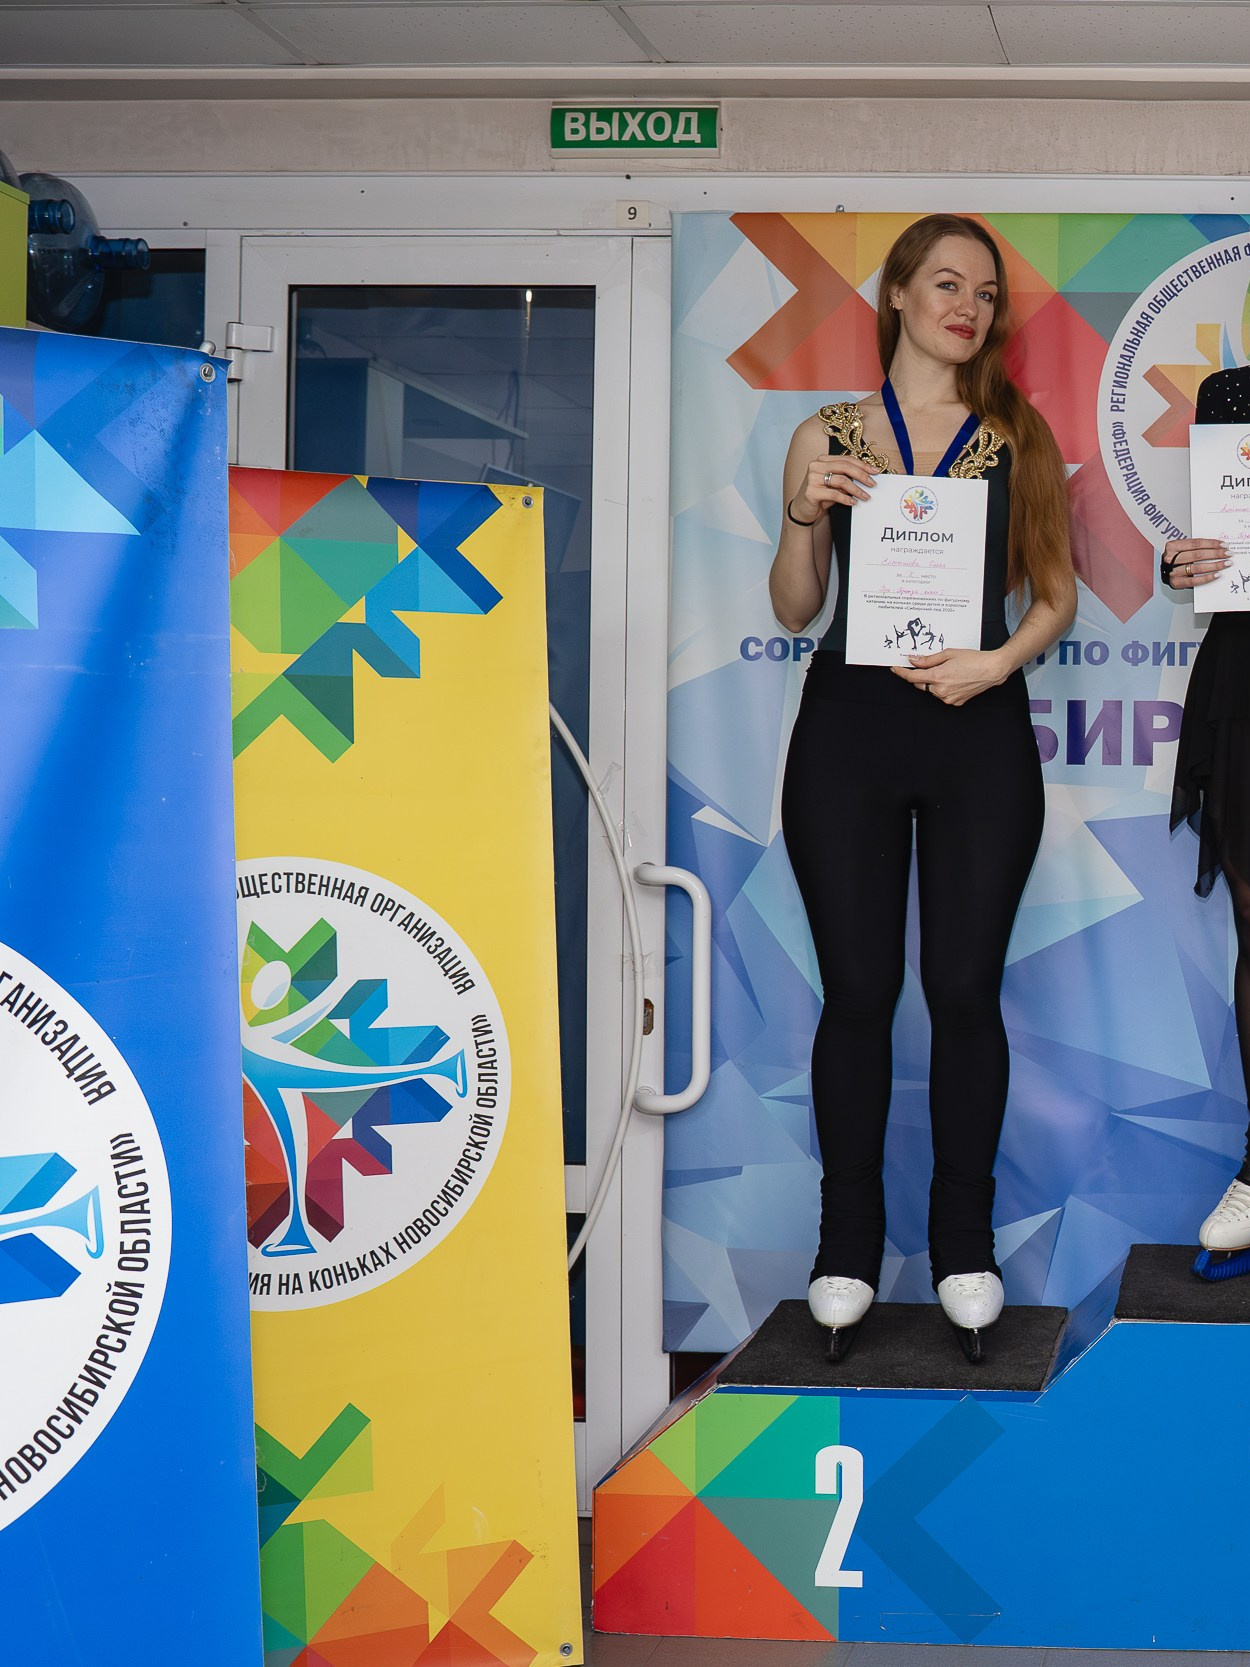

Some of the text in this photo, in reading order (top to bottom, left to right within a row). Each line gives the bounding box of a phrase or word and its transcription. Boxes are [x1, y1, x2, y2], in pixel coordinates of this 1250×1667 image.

[564, 111, 702, 144] ВЫХОД
[627, 206, 637, 220] 9
[1110, 311, 1155, 413] РЕГИОНАЛЬНАЯ
[1147, 245, 1242, 315] ОБЩЕСТВЕННАЯ
[1110, 421, 1150, 506] «ФЕДЕРАЦИЯ
[881, 526, 954, 543] Диплом
[890, 546, 944, 555] награждается
[1058, 640, 1110, 666] ПО
[370, 892, 477, 997] ОРГАНИЗАЦИЯ
[0, 970, 117, 1107] ГАНИЗАЦИЯ
[279, 1013, 500, 1296] НА КОНЬКАХ НОВОСИБИРСКОЙ ОБЛАСТИ»
[0, 1132, 152, 1500] НОВОСИБИРСКОЙ ОБЛАСТИ»
[814, 1444, 864, 1588] 2
